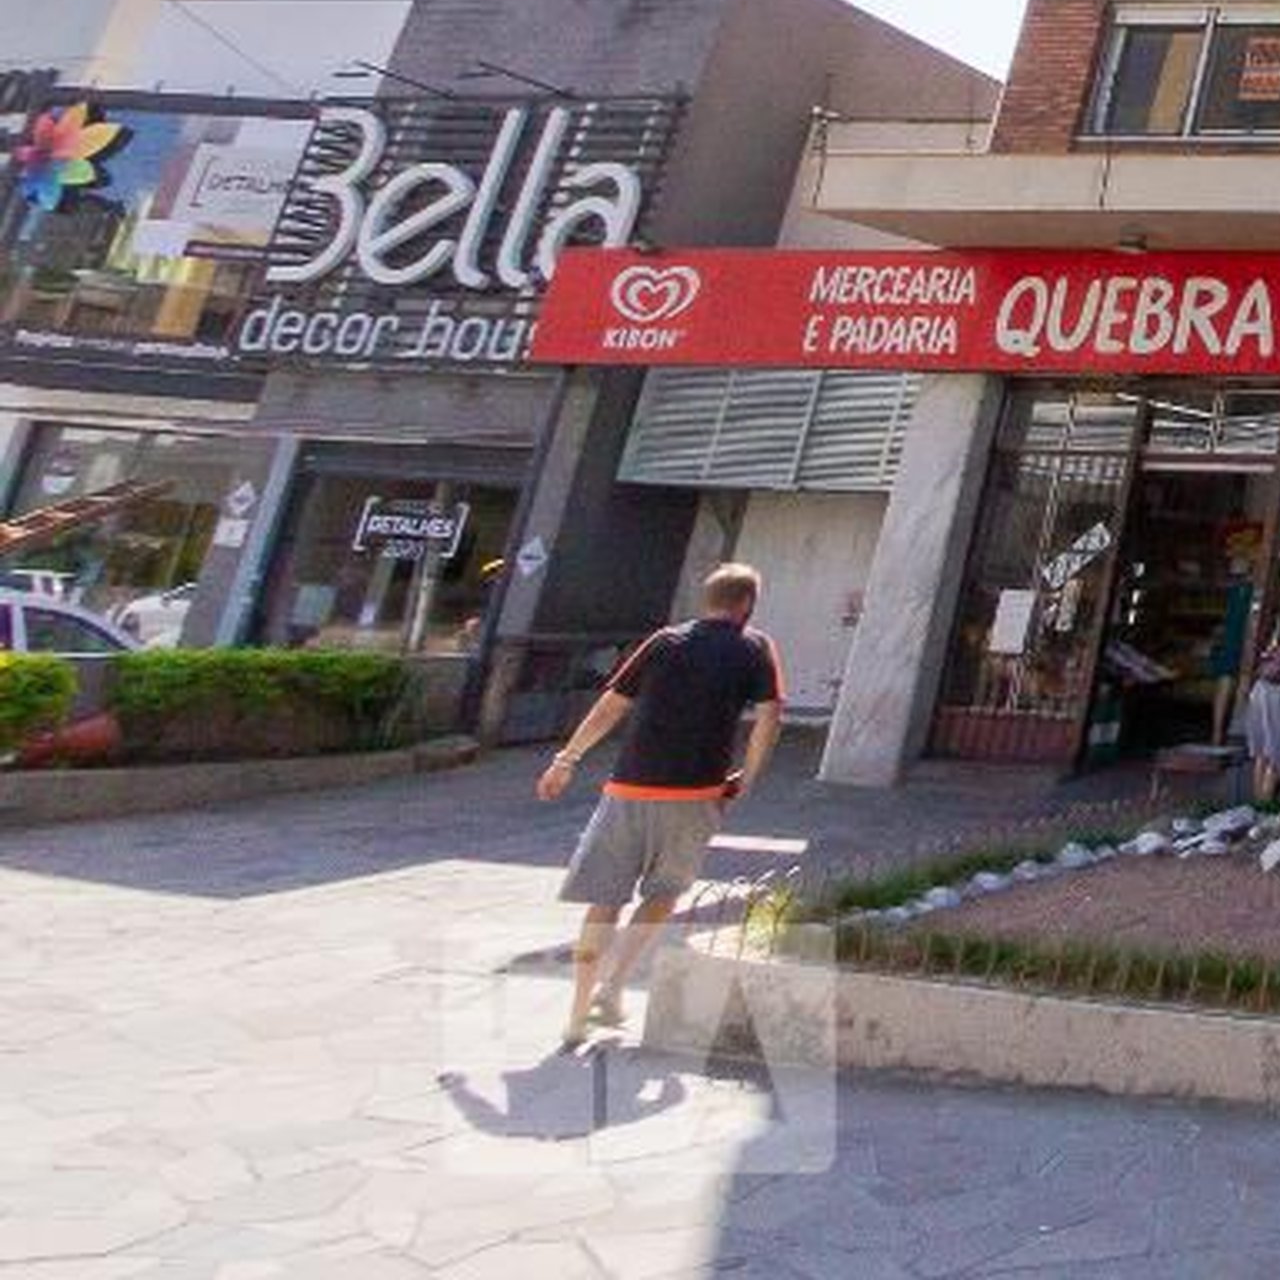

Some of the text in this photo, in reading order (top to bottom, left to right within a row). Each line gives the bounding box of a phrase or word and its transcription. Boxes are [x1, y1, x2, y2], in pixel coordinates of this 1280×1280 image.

[265, 106, 643, 289] Bella
[808, 265, 977, 306] MERCEARIA
[238, 295, 398, 357] decor
[602, 327, 677, 350] KIBON
[802, 314, 959, 355] E PADARIA
[995, 275, 1275, 358] QUEBRA
